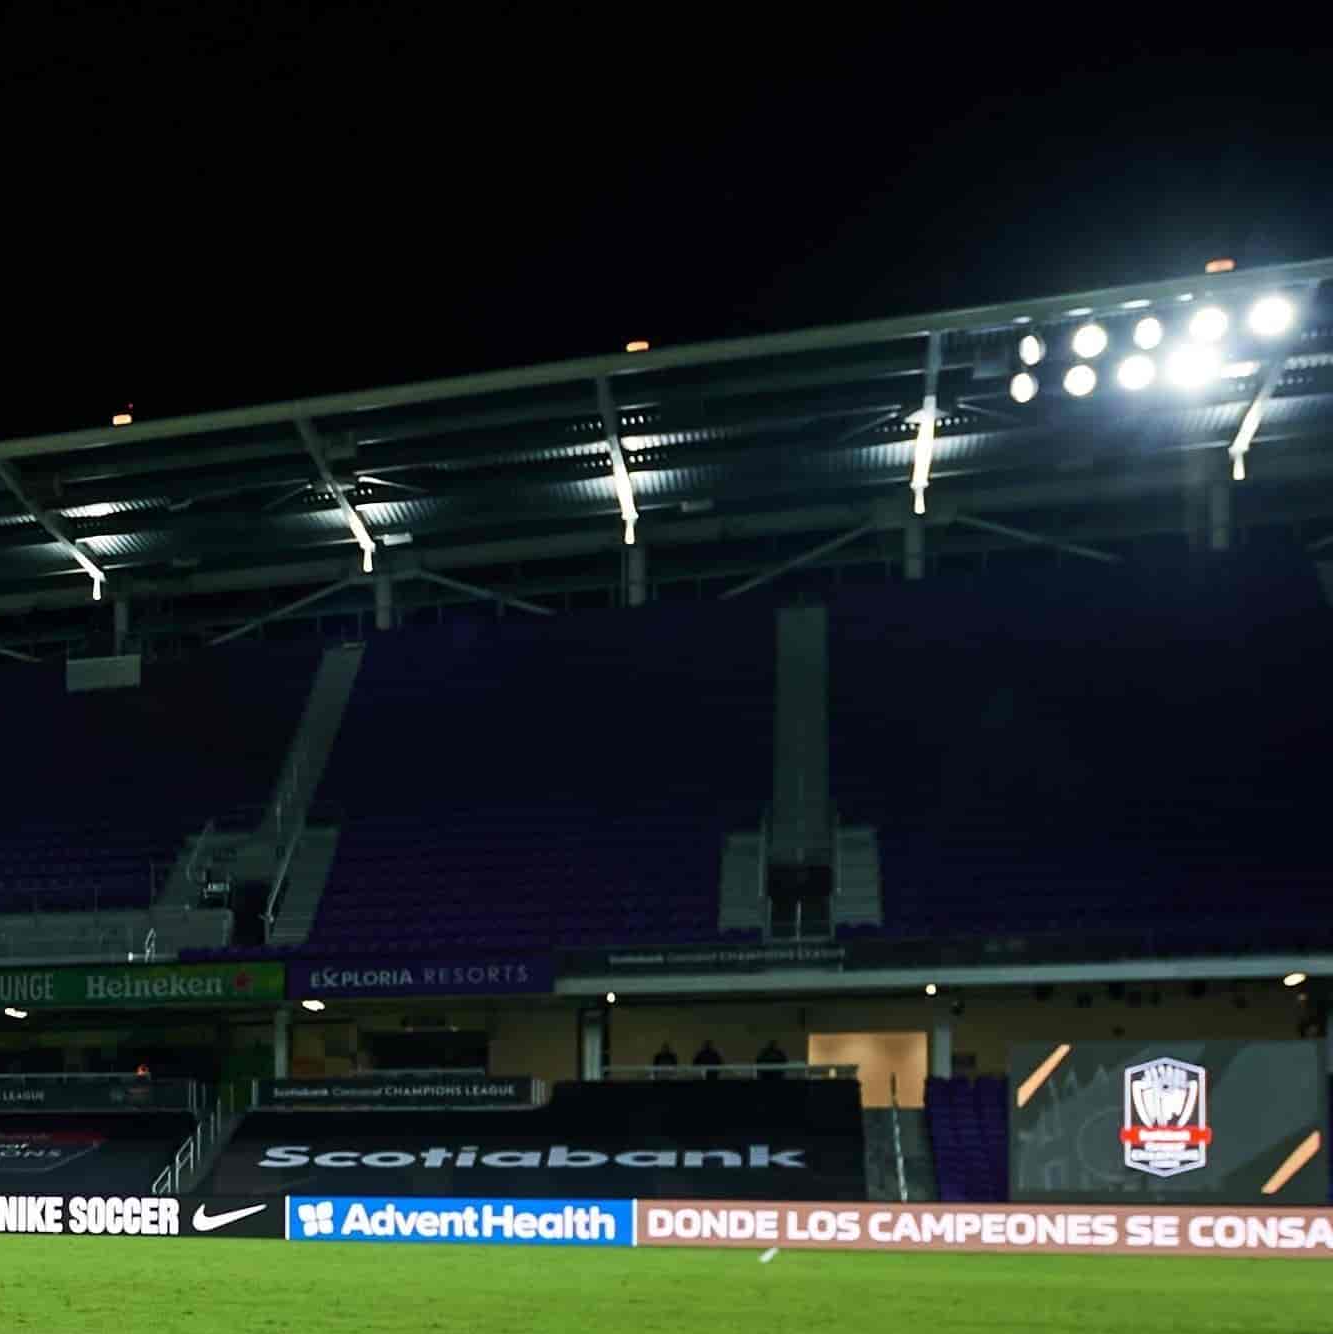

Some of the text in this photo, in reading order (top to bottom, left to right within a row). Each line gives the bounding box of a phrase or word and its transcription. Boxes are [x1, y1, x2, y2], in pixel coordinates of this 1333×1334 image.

[423, 964, 529, 985] RESORTS
[85, 974, 223, 1000] Heineken
[384, 1085, 462, 1097] CHAMPIONS
[465, 1084, 515, 1096] LEAGUE
[258, 1145, 807, 1168] Scotiabank
[69, 1197, 180, 1235] SOCCER
[648, 1208, 780, 1240] DONDE
[787, 1210, 860, 1241] LOS
[868, 1211, 1118, 1246] CAMPEONES
[1125, 1214, 1180, 1247] SE
